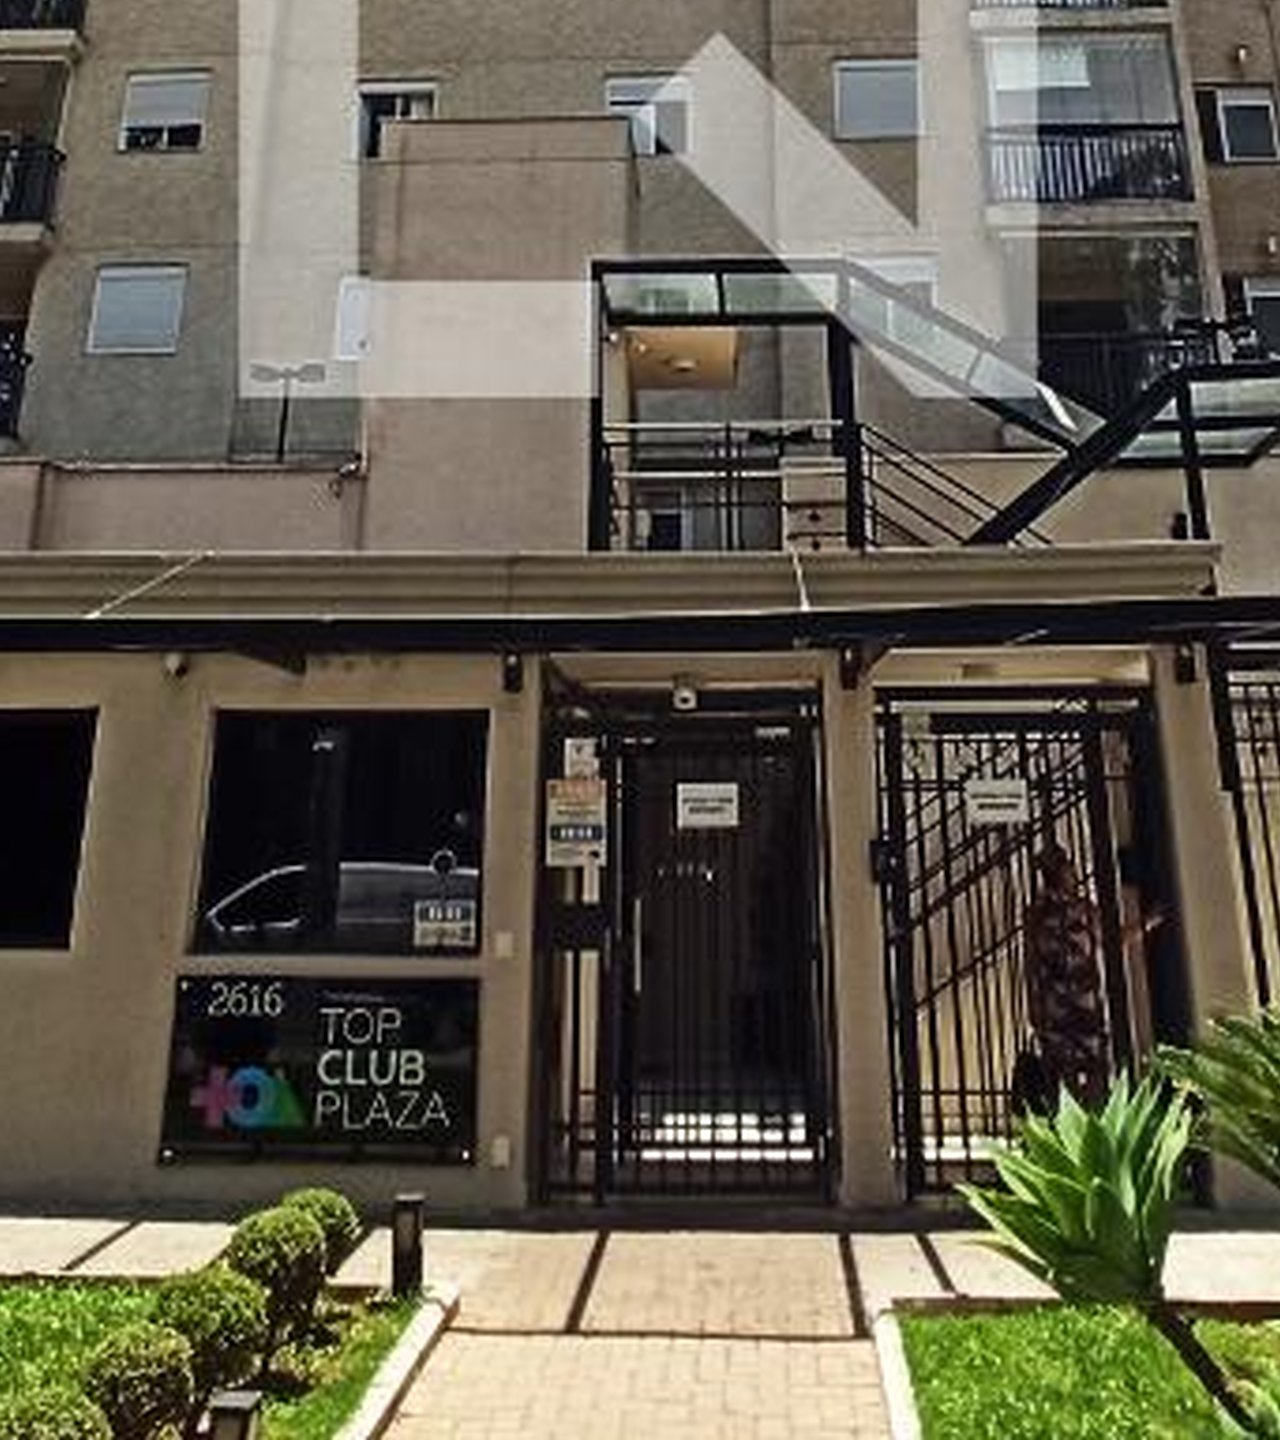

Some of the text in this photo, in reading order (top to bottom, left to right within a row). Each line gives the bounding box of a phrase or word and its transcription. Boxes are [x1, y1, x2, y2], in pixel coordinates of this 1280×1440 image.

[208, 981, 283, 1017] 2616
[320, 1007, 402, 1045] TOP
[317, 1048, 426, 1086] CLUB
[314, 1090, 450, 1130] PLAZA
